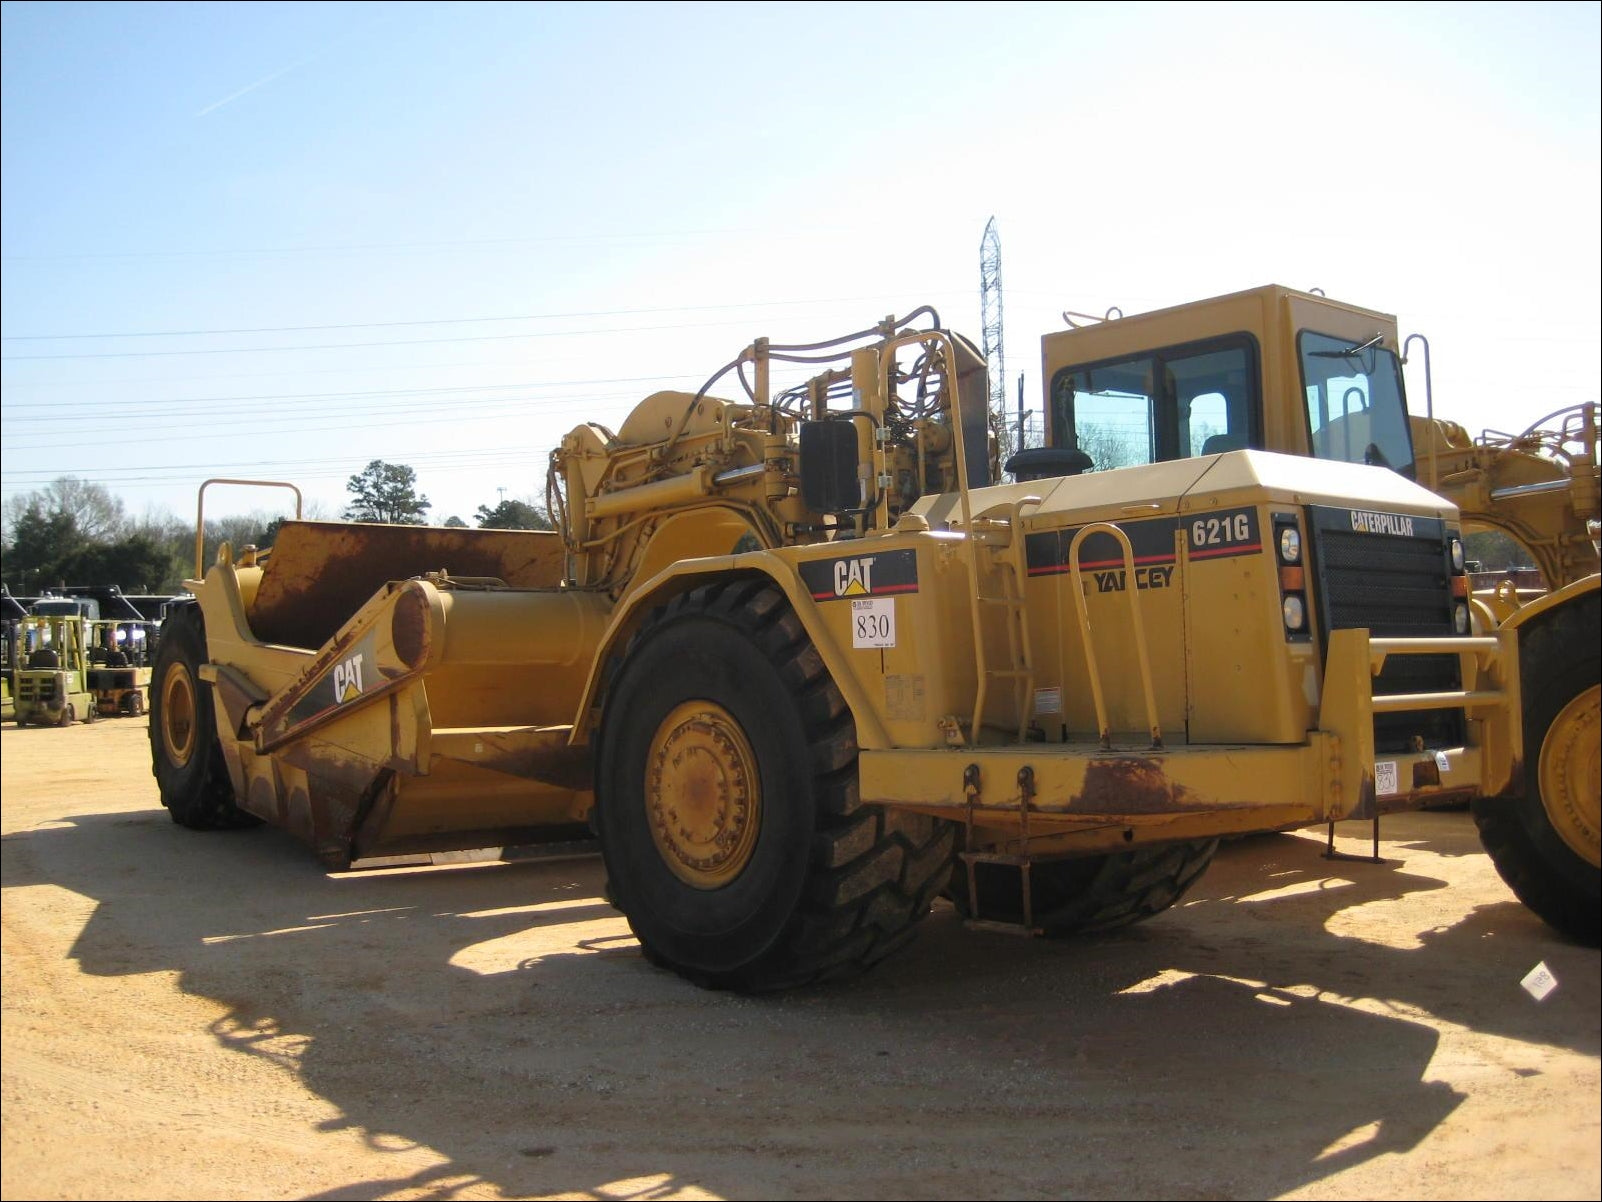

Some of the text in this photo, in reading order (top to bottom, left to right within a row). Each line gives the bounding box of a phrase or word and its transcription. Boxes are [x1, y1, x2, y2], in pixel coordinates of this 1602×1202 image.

[1192, 513, 1250, 546] 621G
[1350, 510, 1414, 537] CATERPILLAR
[833, 557, 875, 596] CAT
[857, 614, 890, 639] 830
[333, 653, 364, 704] CAT
